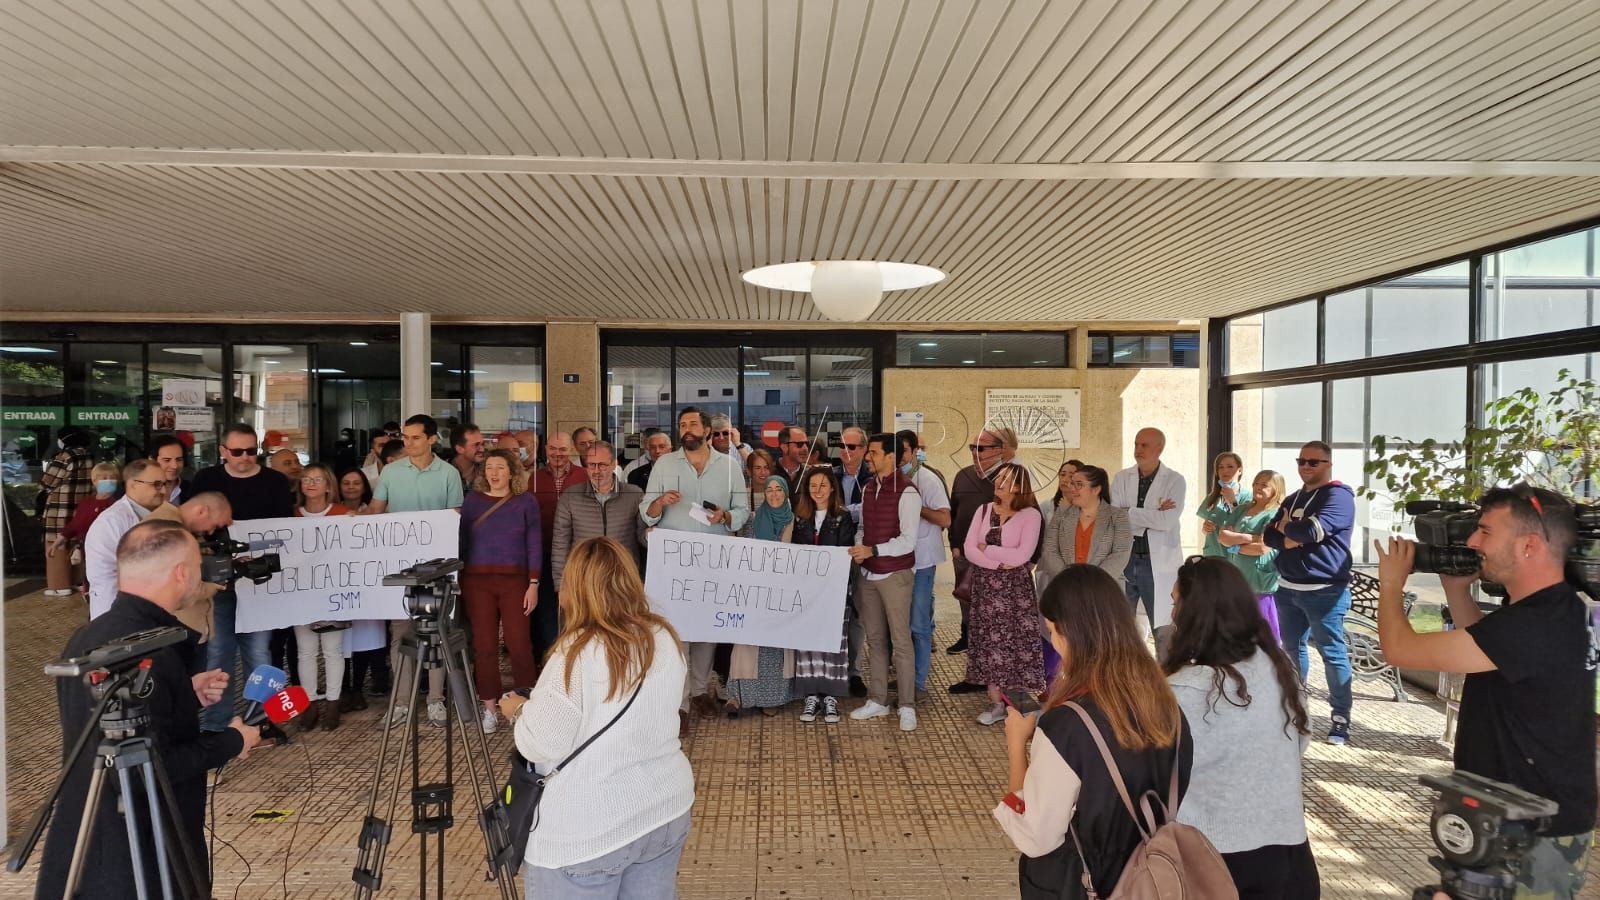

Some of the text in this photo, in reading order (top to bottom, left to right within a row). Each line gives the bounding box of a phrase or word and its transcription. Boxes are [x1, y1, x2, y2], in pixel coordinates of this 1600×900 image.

[4, 412, 56, 420] ENTRADA
[78, 412, 130, 420] ENTRADA
[301, 524, 342, 553] UNA
[350, 520, 434, 549] SANIDAD
[663, 539, 832, 577] POR UN AUMENTO
[338, 561, 361, 587] DE
[328, 591, 361, 612] SMM
[670, 578, 803, 614] DE PLANTILLA
[713, 611, 745, 629] SMM
[277, 690, 295, 712] rne
